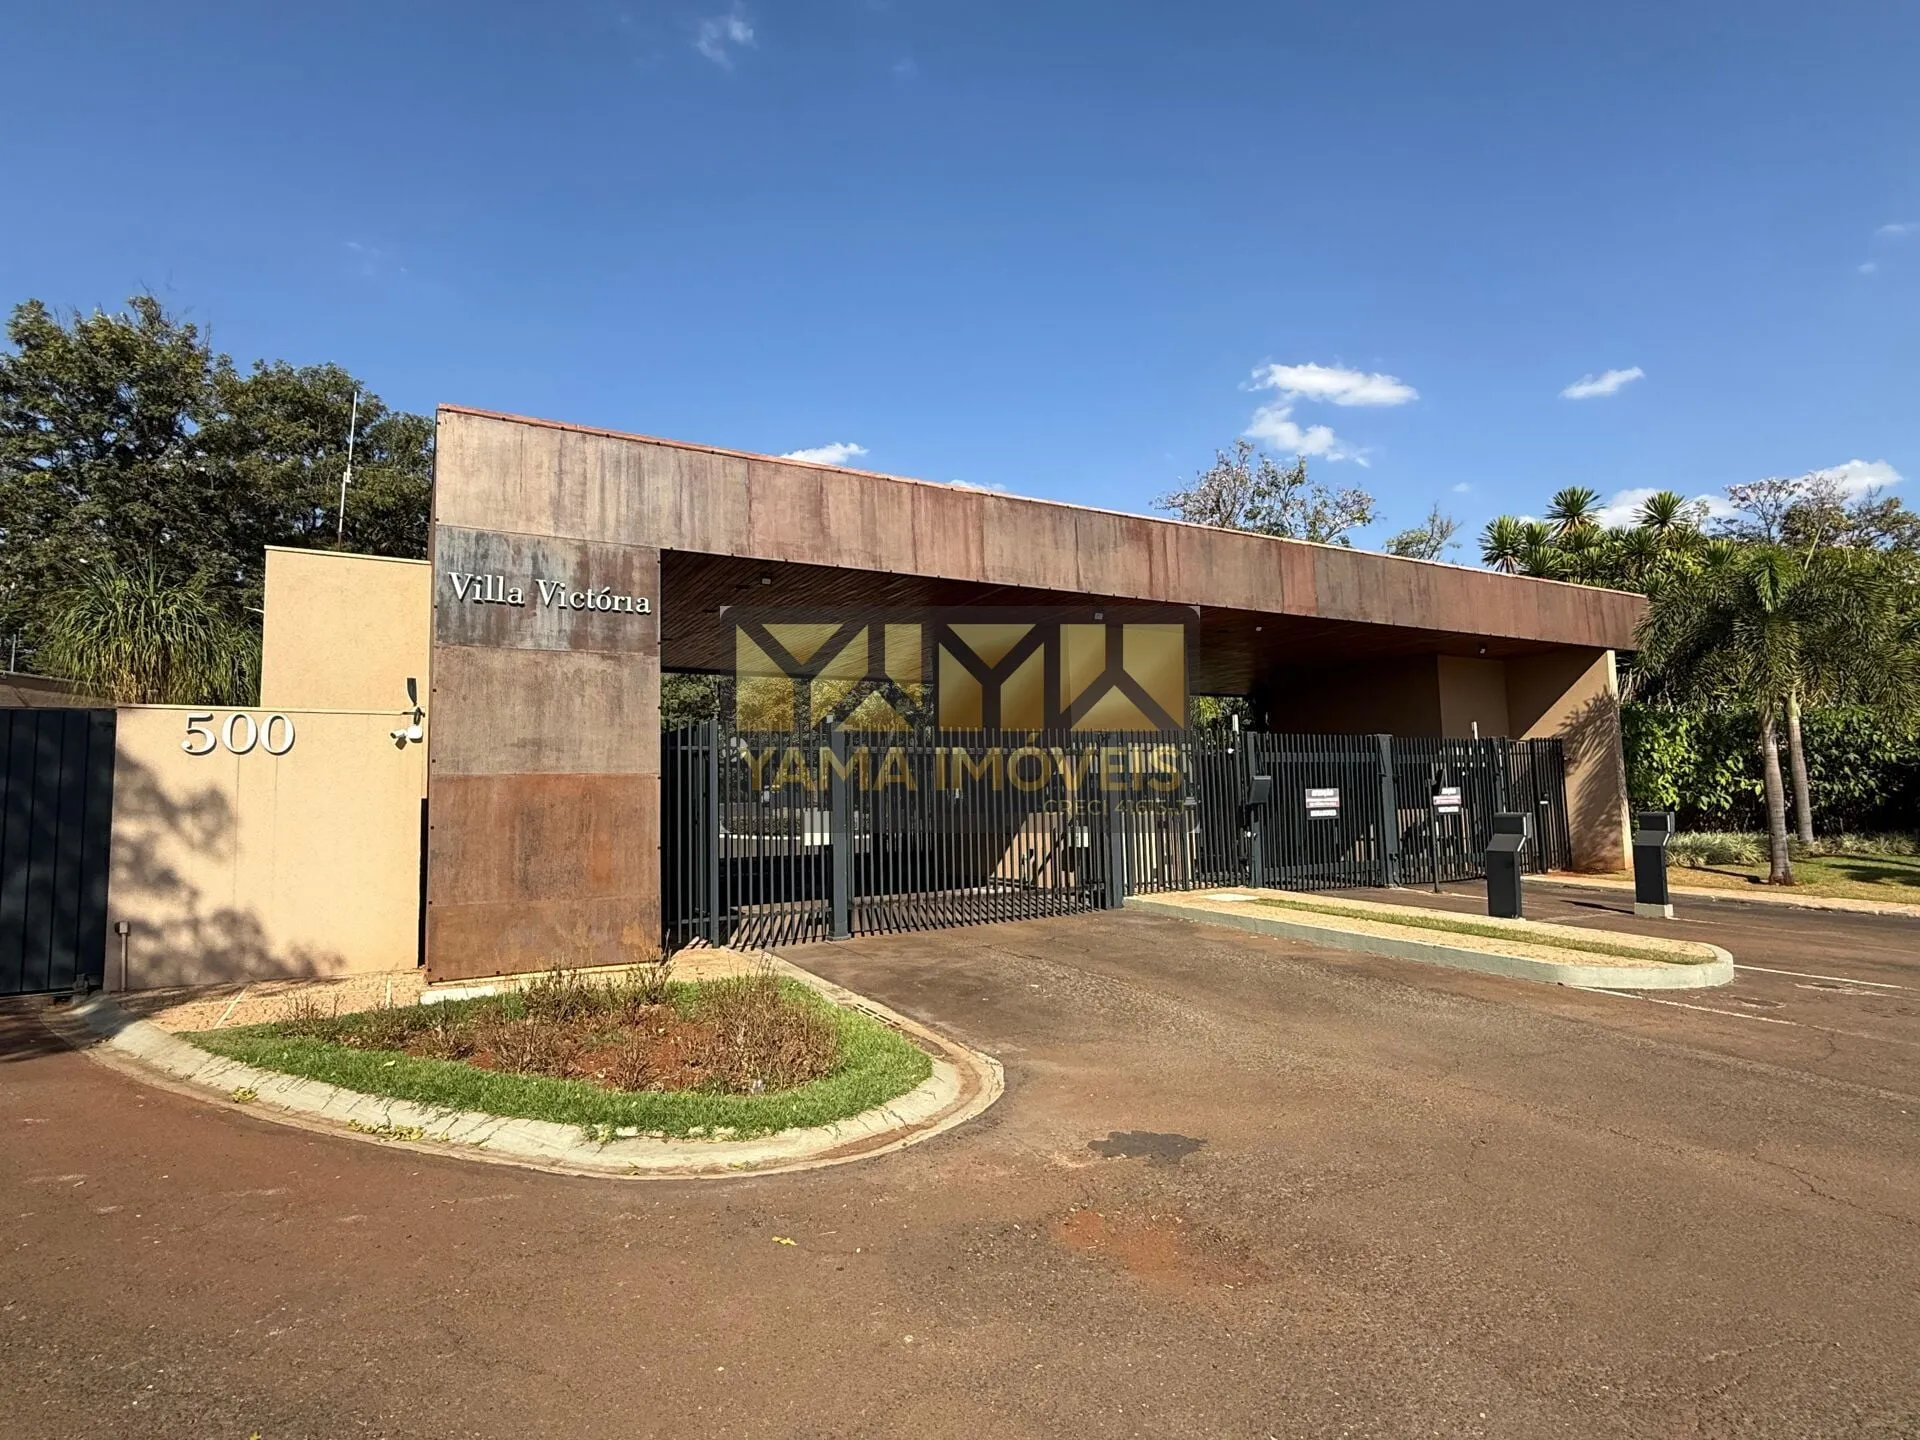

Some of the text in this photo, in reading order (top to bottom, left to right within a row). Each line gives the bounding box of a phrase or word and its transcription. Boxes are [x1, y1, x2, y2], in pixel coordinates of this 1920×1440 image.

[448, 571, 652, 614] Villa Victória
[181, 712, 296, 755] 500
